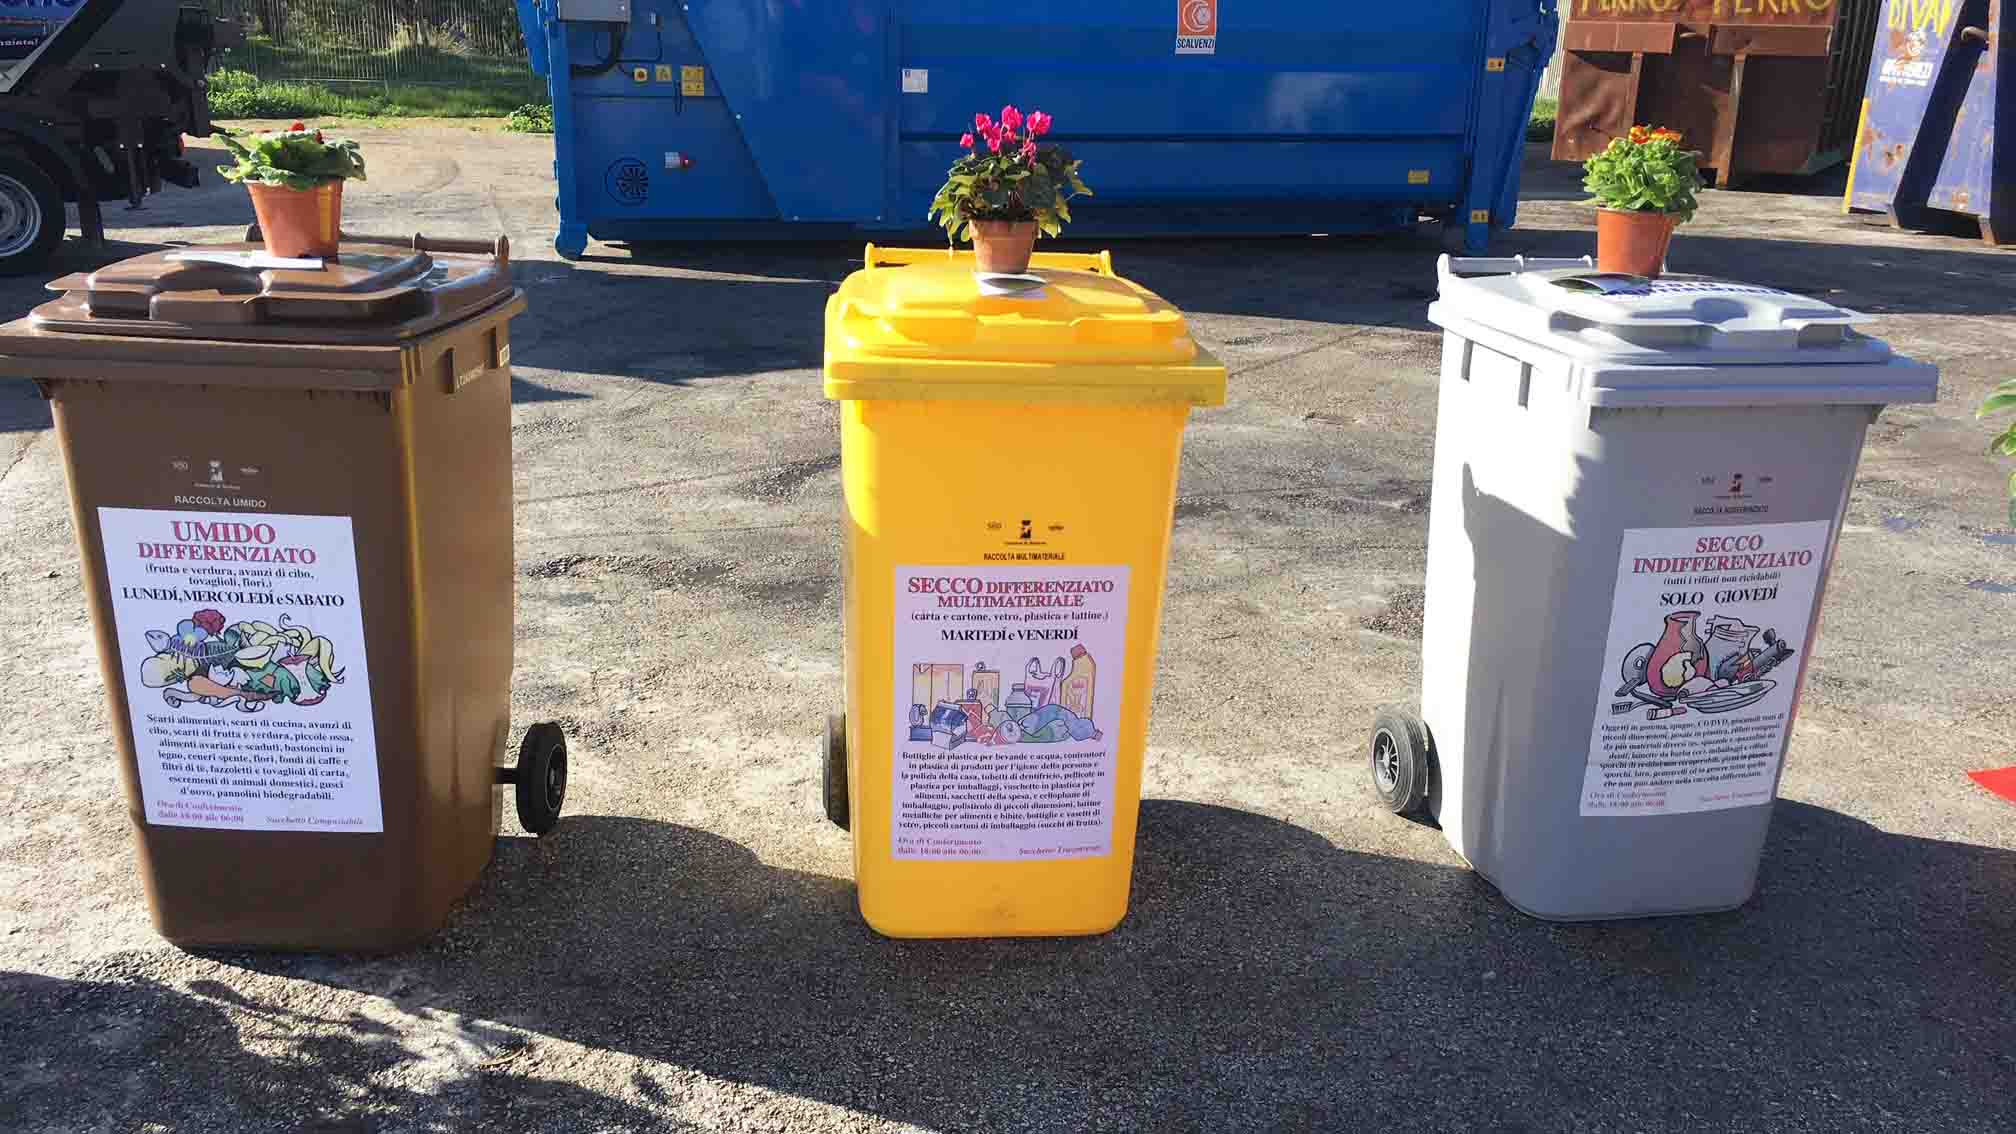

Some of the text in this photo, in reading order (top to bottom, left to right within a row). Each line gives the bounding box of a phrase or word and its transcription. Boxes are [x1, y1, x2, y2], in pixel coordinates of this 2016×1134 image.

[1177, 38, 1216, 49] SCALVENZI
[174, 495, 267, 508] RACCOLTA UMIDO
[170, 520, 276, 544] UMIDO
[1695, 536, 1763, 553] SECCO
[136, 541, 317, 564] DIFFERENZIATO
[1633, 551, 1812, 573] INDIFFERENZIATO
[144, 564, 180, 575] (frutta
[190, 566, 235, 577] verdura,
[237, 568, 272, 577] avanzi
[274, 569, 286, 577] di
[287, 570, 315, 580] cibo,
[187, 576, 240, 587] tovaglioli,
[908, 577, 1114, 594] SECCO DIFFERENZIATO
[1693, 574, 1719, 584] rifiuti
[276, 596, 284, 604] e
[283, 592, 345, 606] SABATO
[937, 594, 1084, 608] MULTIMATERIALE
[1660, 592, 1703, 605] SOLO
[911, 612, 940, 623] (carta
[950, 612, 991, 623] cartone,
[993, 612, 1022, 622] vetro,
[1024, 611, 1061, 622] plastica
[146, 714, 175, 723] Scarti
[176, 716, 229, 727] alimentari,
[230, 717, 257, 726] scarti
[271, 719, 306, 729] cucina,
[307, 720, 339, 729] avanzi
[148, 727, 172, 737] cibo,
[173, 728, 199, 736] scarti
[213, 729, 240, 737] frutta
[251, 731, 293, 741] verdura,
[293, 732, 327, 742] piccole
[158, 739, 196, 747] alimenti
[198, 740, 235, 749] avariati
[245, 742, 283, 752] scaduti,
[284, 743, 333, 752] bastoncini
[335, 745, 345, 753] in
[157, 751, 186, 761] legno,
[187, 752, 216, 760] ceneri
[218, 753, 252, 763] spente,
[253, 754, 278, 764] fiori,
[278, 755, 303, 763] fondi
[305, 756, 315, 764] di
[902, 752, 935, 762] Bottiglie
[947, 752, 977, 762] plastica
[980, 754, 992, 762] per
[995, 752, 1027, 760] bevande
[1036, 753, 1063, 761] acqua,
[161, 763, 183, 771] filtri
[209, 765, 252, 773] fazzoletti
[261, 766, 306, 777] tovaglioli
[307, 768, 318, 776] di
[319, 768, 350, 778] carta,
[918, 761, 948, 771] plastica
[960, 761, 993, 771] prodotti
[1040, 761, 1059, 769] della
[1062, 762, 1092, 770] persona
[168, 775, 217, 784] escrementi
[230, 777, 267, 786] animali
[268, 779, 318, 789] domestici,
[319, 780, 344, 790] gusci
[938, 771, 957, 779] della
[959, 773, 980, 781] casa,
[981, 771, 1007, 780] tubetti
[1019, 771, 1062, 781] dentifricio,
[910, 781, 940, 791] plastica
[957, 781, 1002, 792] imballaggi,
[1050, 780, 1080, 790] plastica
[1082, 781, 1095, 789] per
[216, 788, 261, 799] pannolini
[262, 790, 335, 801] biodegradabili.
[914, 790, 1080, 801] alimenti, sacchetti della spesa, cellophane
[902, 800, 950, 811] imballaggio,
[952, 801, 992, 812] polistirolo
[1003, 801, 1028, 811] piccoli
[1030, 800, 1075, 810] dimensioni,
[944, 813, 957, 821] per
[959, 811, 991, 819] alimenti
[1000, 811, 1024, 821] bibite,
[1026, 810, 1058, 820] bottiglie
[1066, 808, 1091, 817] vasetti
[923, 820, 948, 831] piccoli
[950, 821, 978, 829] cartoni
[990, 821, 1035, 831] imballaggio
